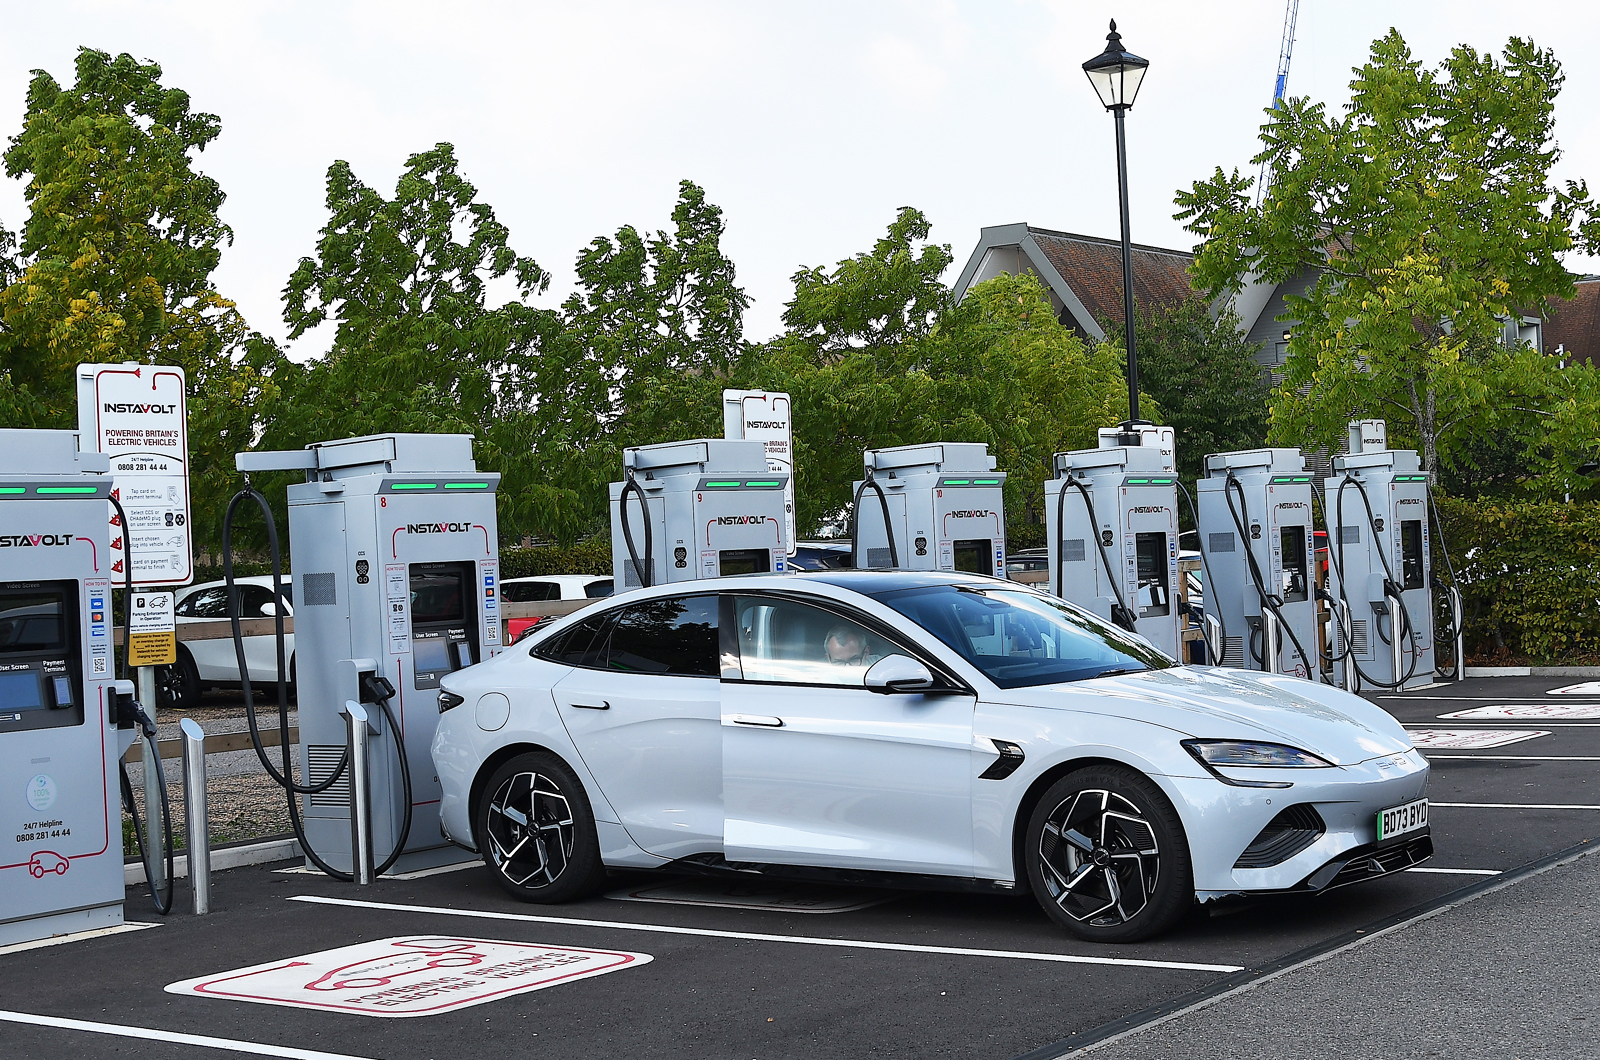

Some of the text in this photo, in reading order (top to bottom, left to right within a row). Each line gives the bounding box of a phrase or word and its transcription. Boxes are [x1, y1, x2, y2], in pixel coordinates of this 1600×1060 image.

[104, 403, 176, 414] INSTAVOLT
[380, 497, 387, 507] 8
[697, 493, 702, 502] 9
[952, 510, 988, 518] INSTAVOLT
[718, 515, 766, 525] INSTAVOLT
[407, 522, 471, 534] INSTAVOLT
[1384, 802, 1426, 834] BD73 BYD
[39, 820, 62, 828] Helpline
[16, 833, 34, 842] 0808
[36, 832, 48, 840] 281
